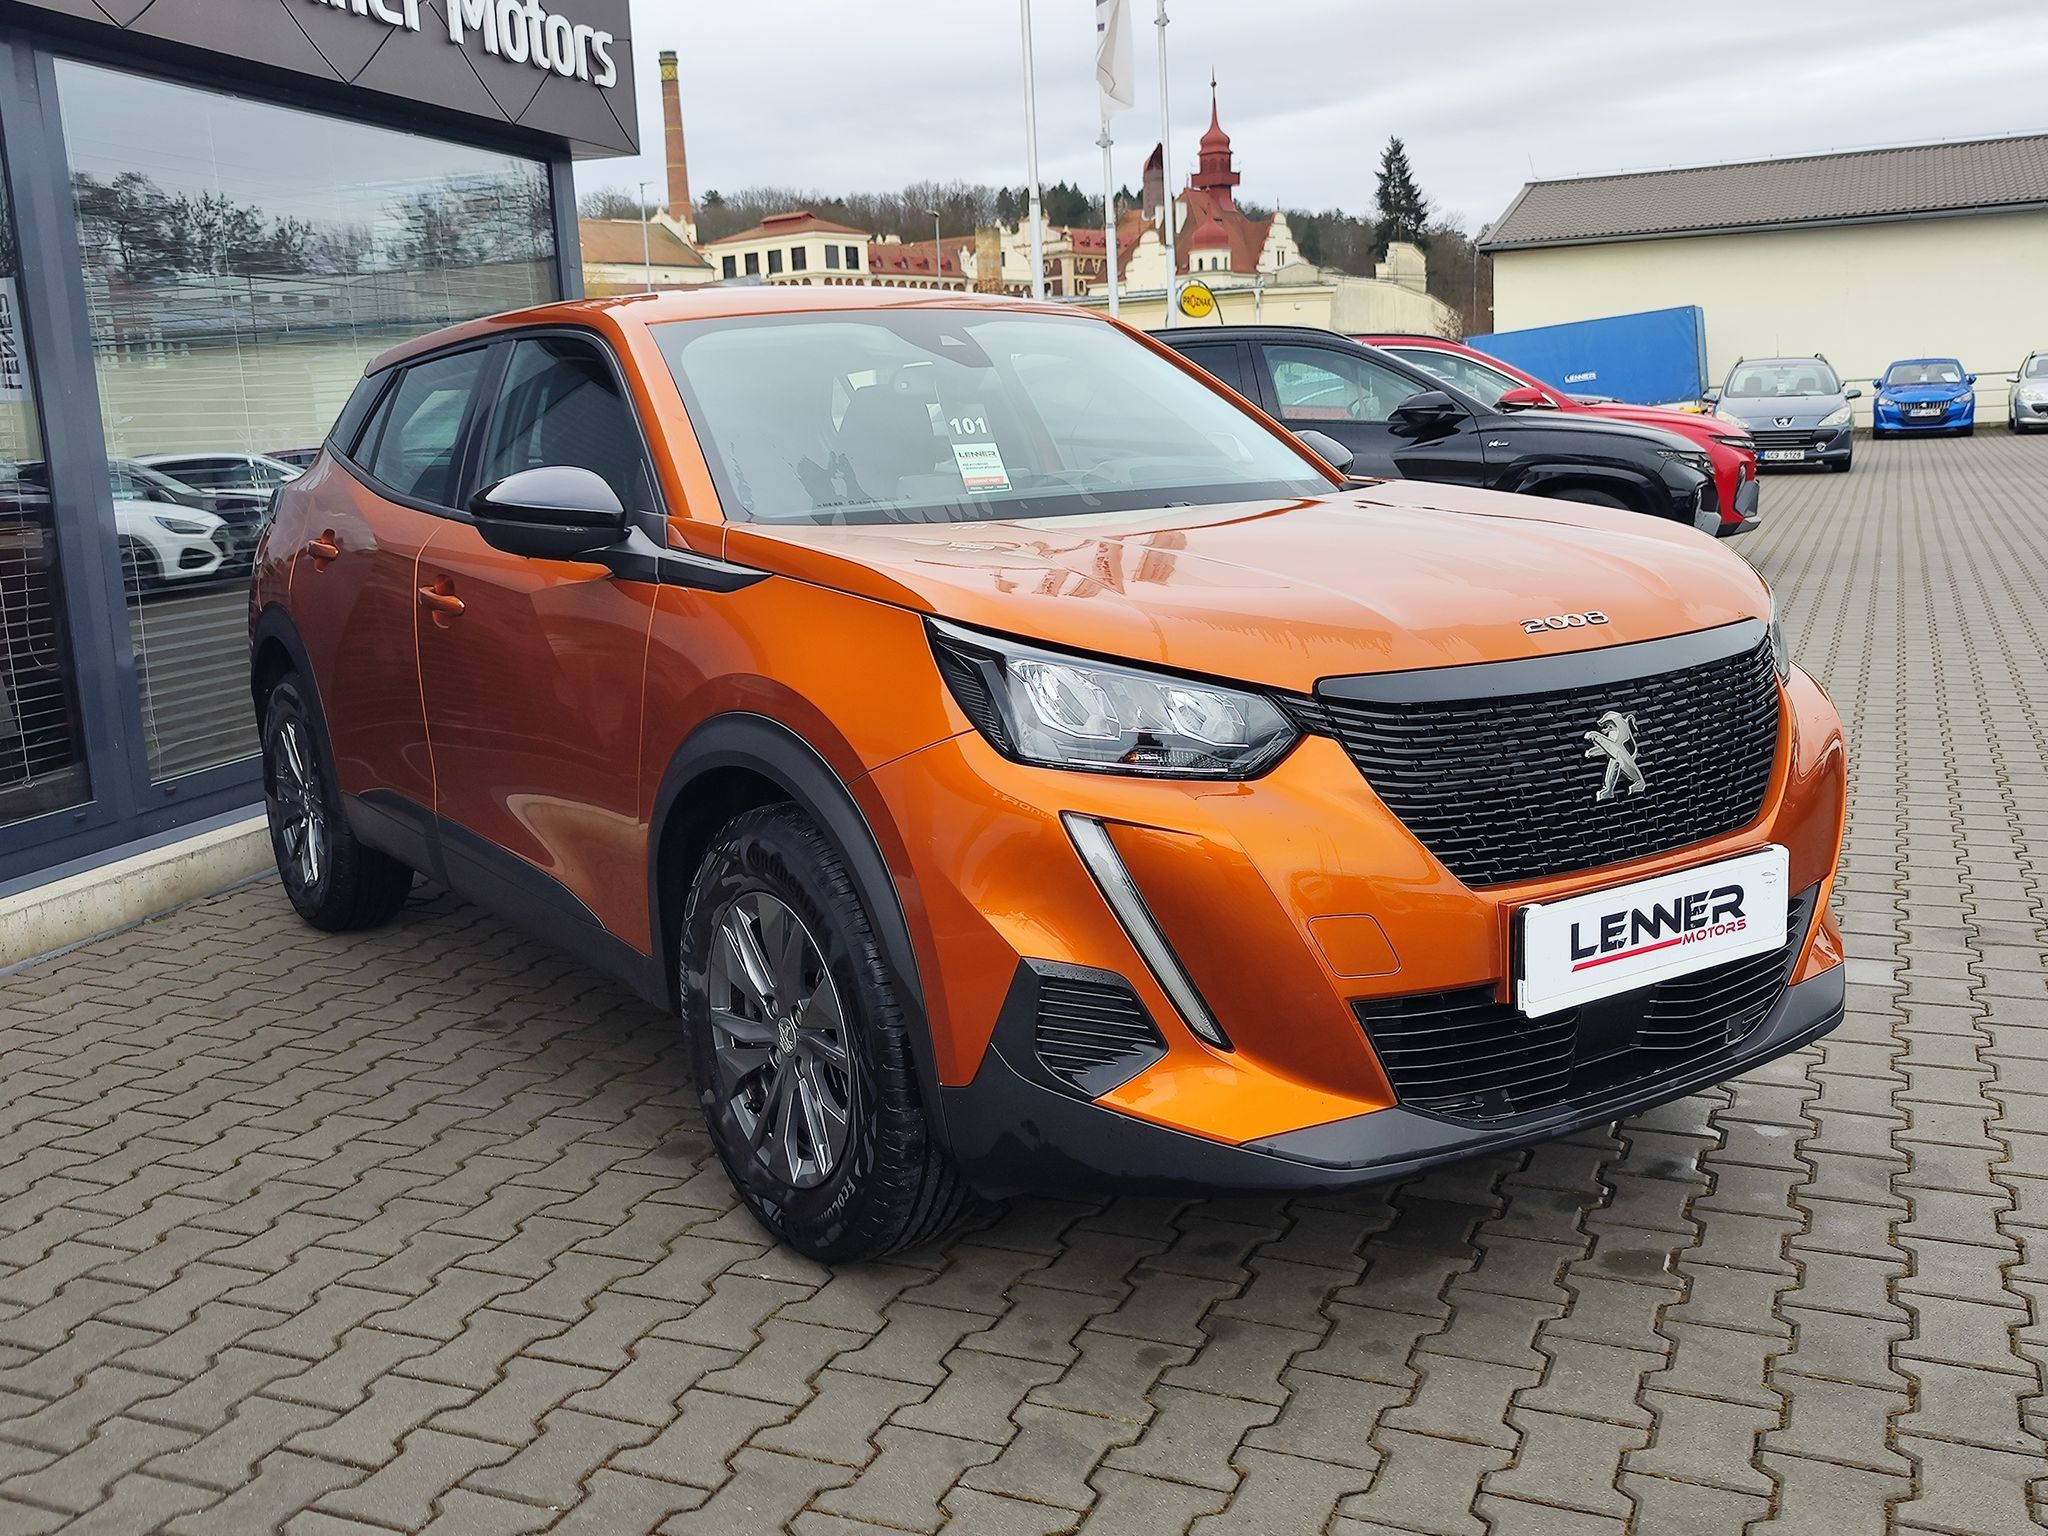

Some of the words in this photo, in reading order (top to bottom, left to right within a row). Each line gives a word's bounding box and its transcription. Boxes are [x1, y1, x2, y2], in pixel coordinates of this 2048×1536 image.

[448, 0, 617, 88] Motors
[949, 417, 987, 434] 101
[1519, 610, 1609, 634] 2008
[1571, 884, 1745, 961] LENNER
[1682, 918, 1747, 945] MOTORS
